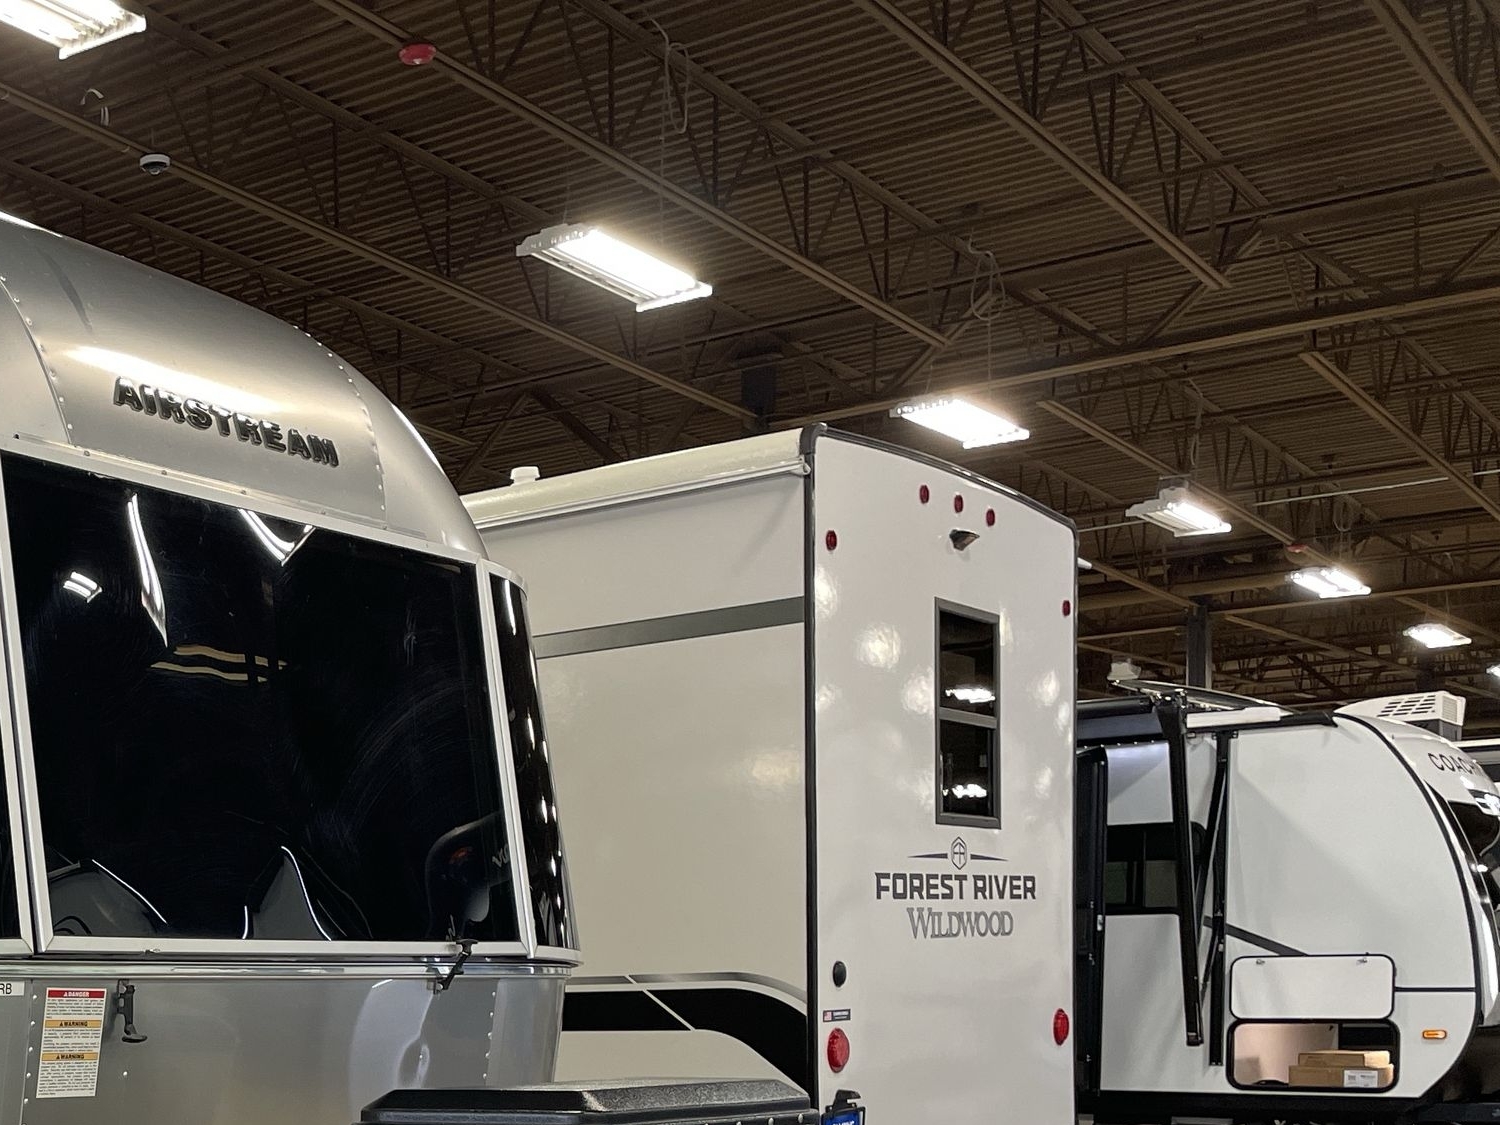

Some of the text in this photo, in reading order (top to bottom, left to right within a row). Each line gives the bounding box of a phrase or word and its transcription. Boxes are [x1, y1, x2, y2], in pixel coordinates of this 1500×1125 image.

[113, 376, 339, 468] AIRSTREAM
[875, 872, 1036, 900] FOREST RIVER
[906, 907, 1014, 939] WILDWOOD
